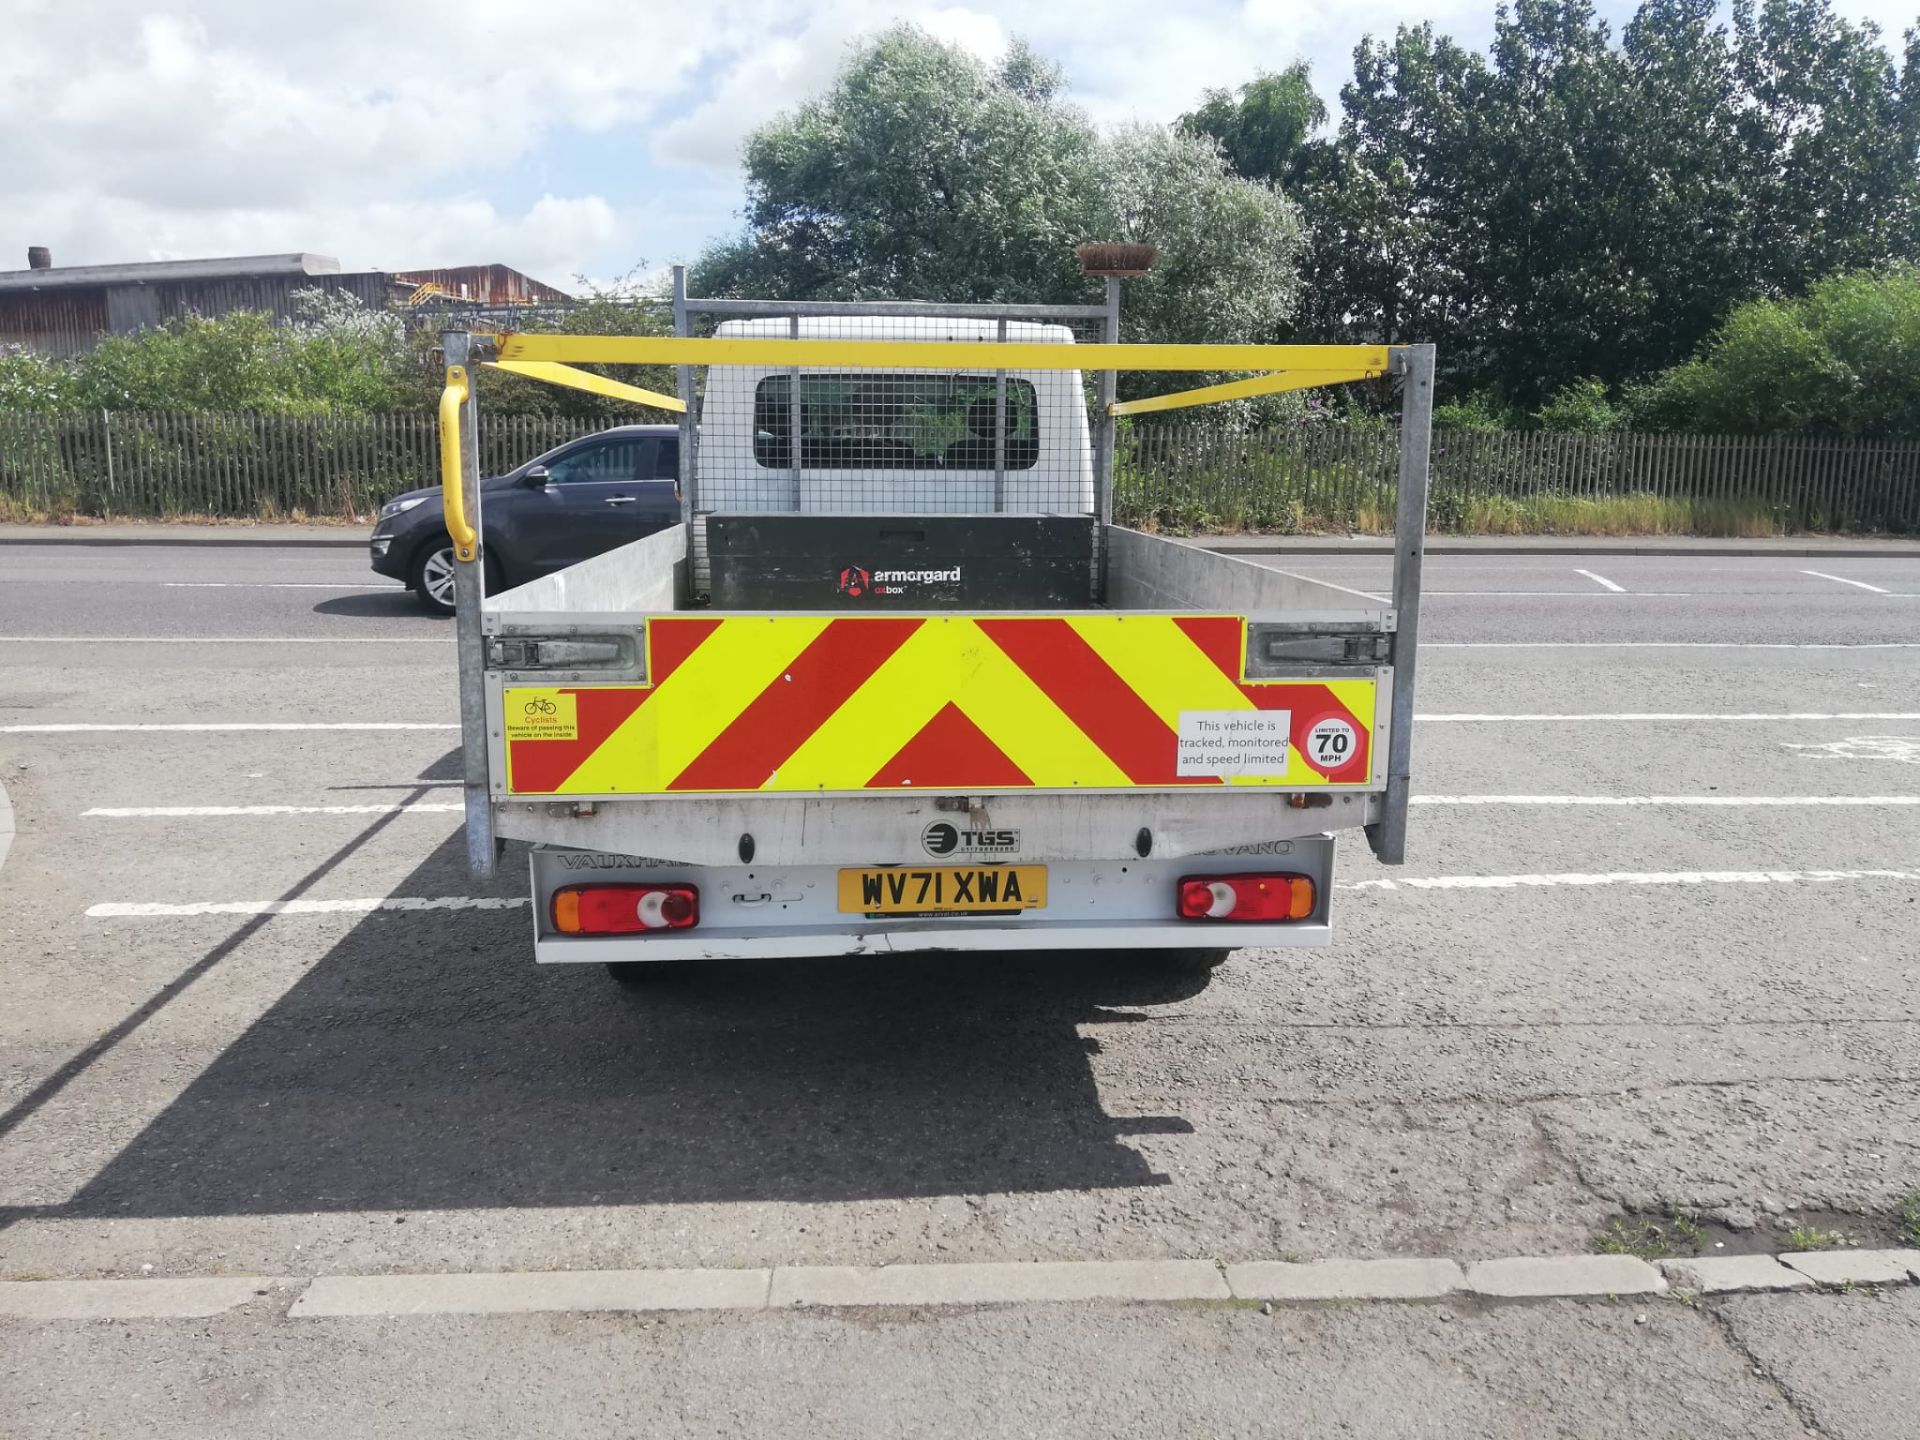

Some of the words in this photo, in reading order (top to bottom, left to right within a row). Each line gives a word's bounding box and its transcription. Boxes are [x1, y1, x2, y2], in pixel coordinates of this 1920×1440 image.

[874, 567, 961, 584] armorgard
[875, 586, 904, 594] oxbox
[525, 716, 557, 725] Cyclists
[1197, 720, 1220, 731] This
[1224, 720, 1264, 731] vehicle
[1268, 721, 1276, 731] is
[1180, 737, 1225, 748] tracked,
[1228, 737, 1288, 748] monitored
[1316, 734, 1348, 753] 70
[1182, 753, 1204, 764] and
[1206, 754, 1241, 767] speed
[1244, 753, 1285, 764] limited
[961, 831, 1015, 846] TGS
[862, 872, 942, 905] WV71
[953, 871, 1022, 903] XWA
